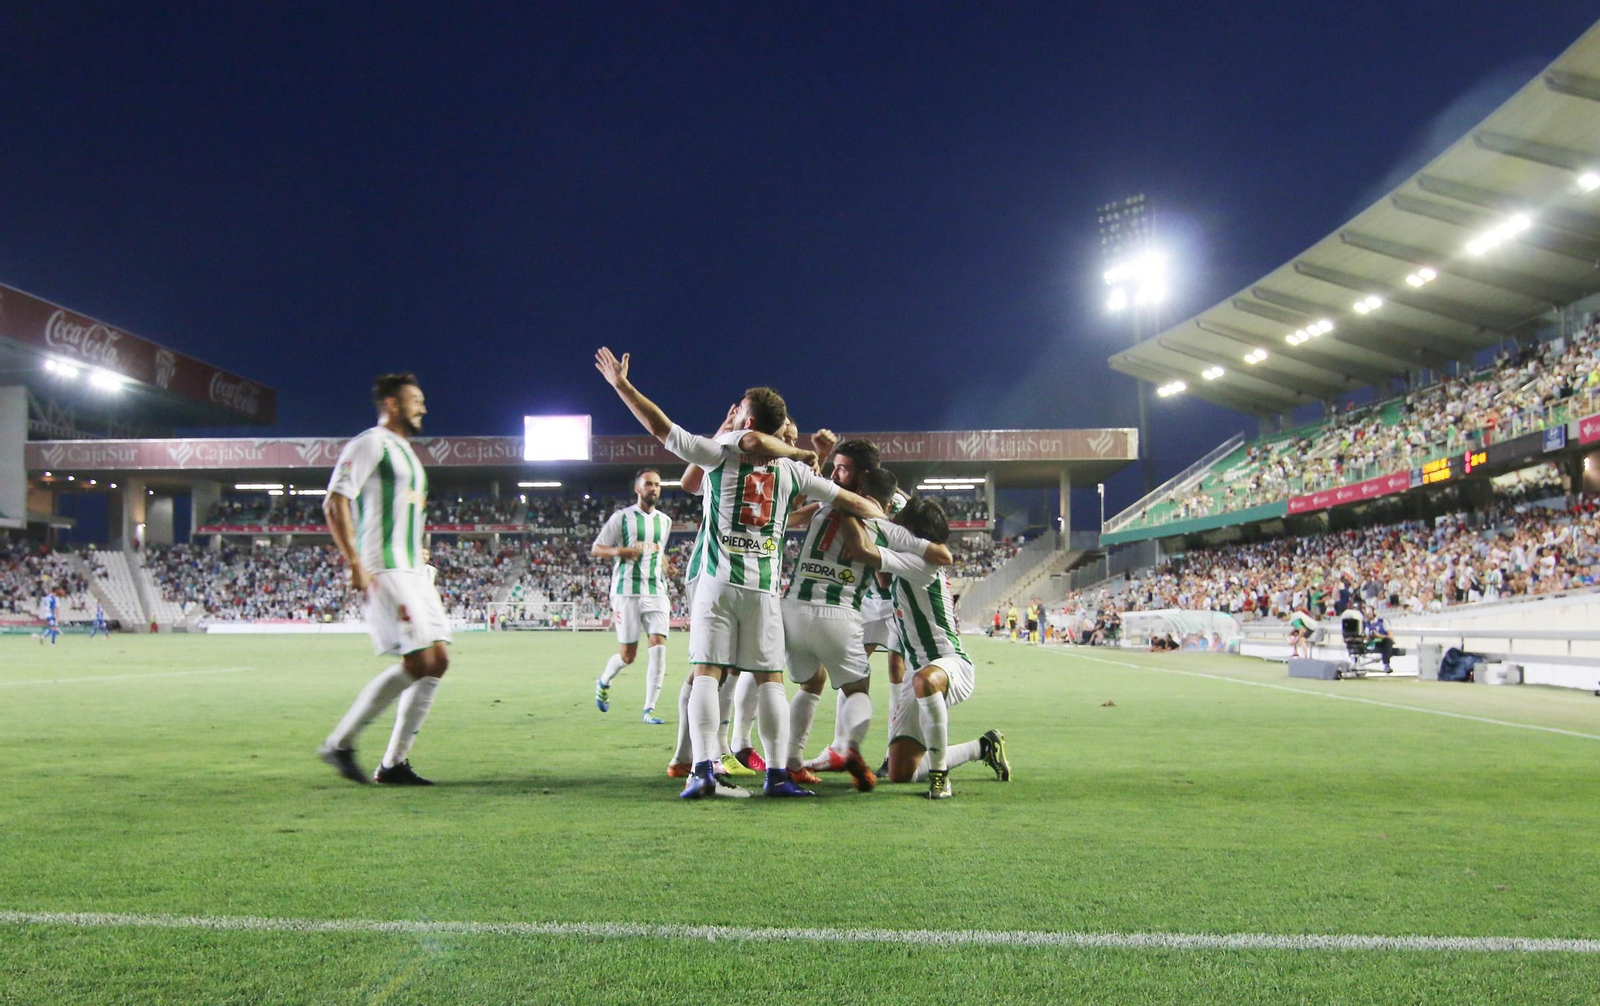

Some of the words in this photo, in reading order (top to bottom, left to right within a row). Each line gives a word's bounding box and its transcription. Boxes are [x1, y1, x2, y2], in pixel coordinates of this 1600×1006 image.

[45, 310, 120, 361] Coca-Cola
[67, 445, 138, 465] CajaSur
[195, 443, 266, 464] CajaSur
[985, 436, 1063, 457] CajaSur
[739, 471, 776, 528] 9
